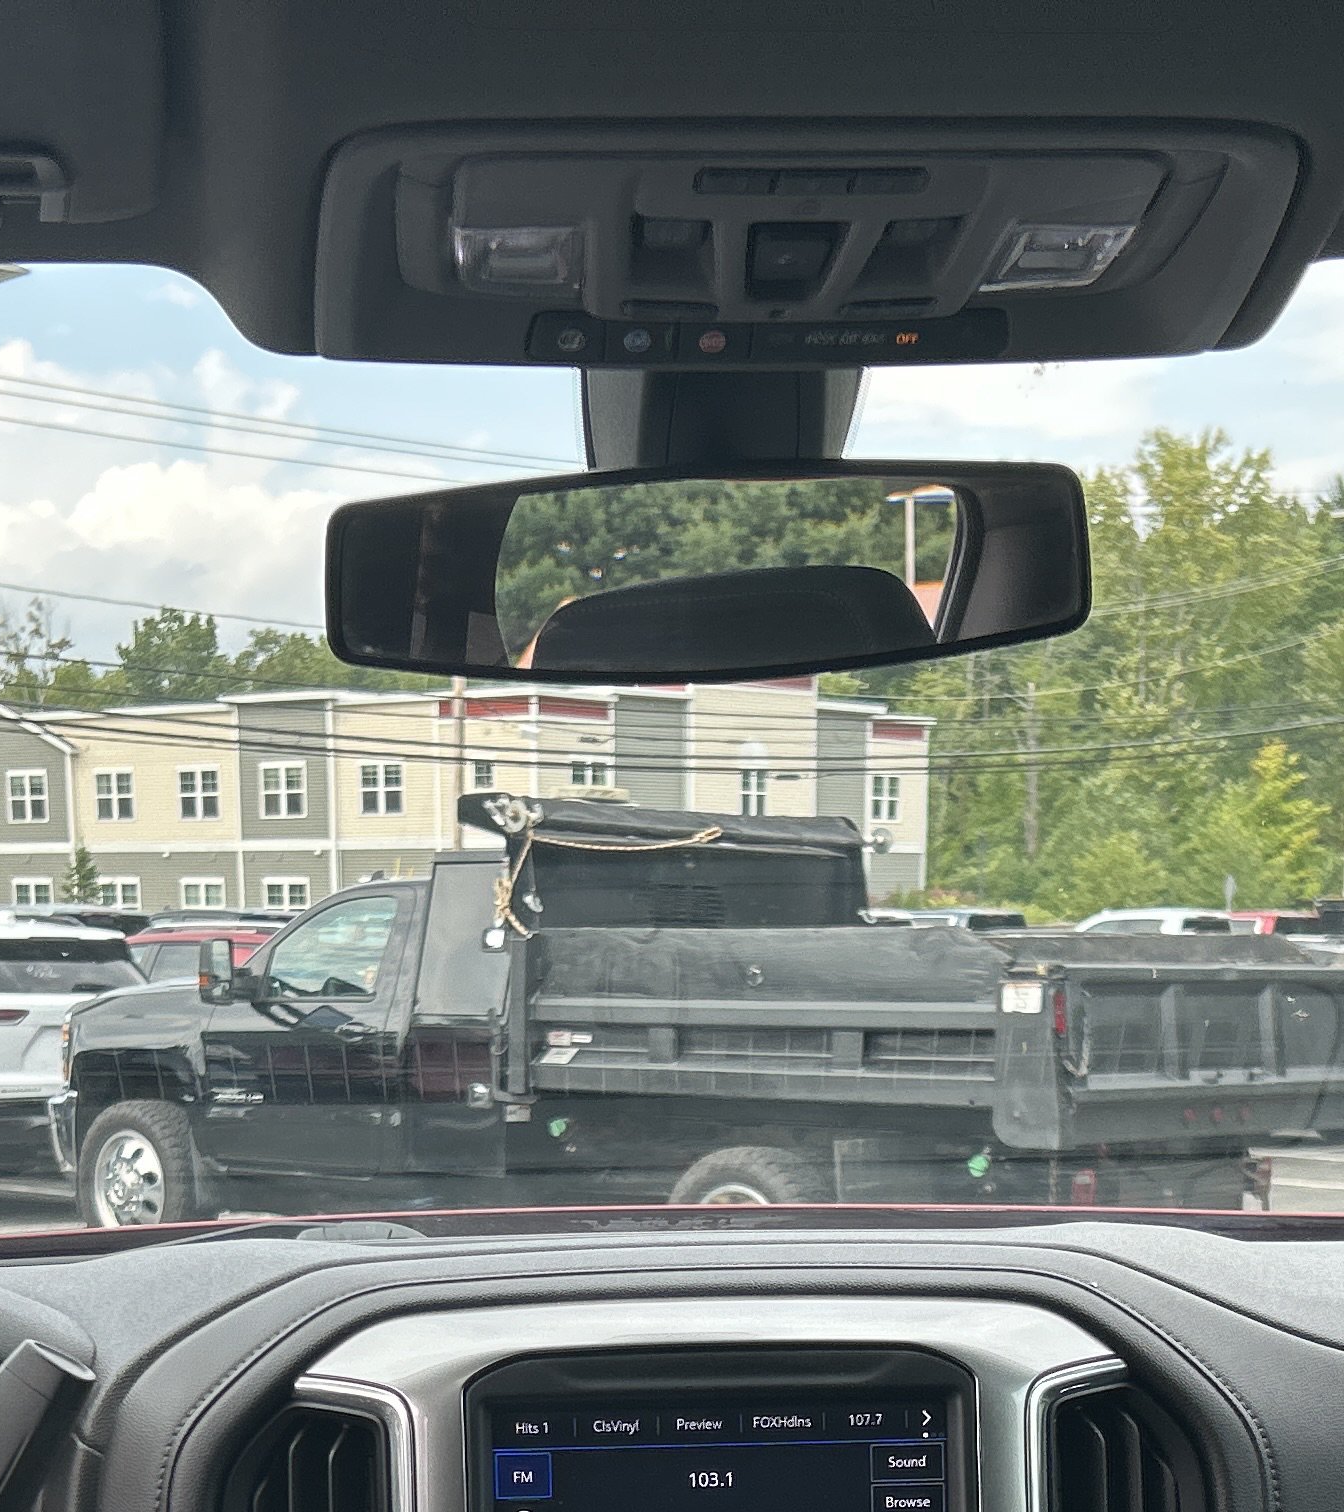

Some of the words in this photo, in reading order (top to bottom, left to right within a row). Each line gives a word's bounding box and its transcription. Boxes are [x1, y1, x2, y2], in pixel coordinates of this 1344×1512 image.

[896, 332, 918, 345] OFF
[676, 1417, 723, 1431] Preview
[848, 1413, 883, 1426] 107.7
[515, 1422, 540, 1435] Hits
[543, 1422, 549, 1434] 1
[888, 1455, 926, 1469] Sound
[513, 1470, 534, 1484] FM
[688, 1472, 734, 1488] 103.1
[885, 1495, 931, 1509] Browse
